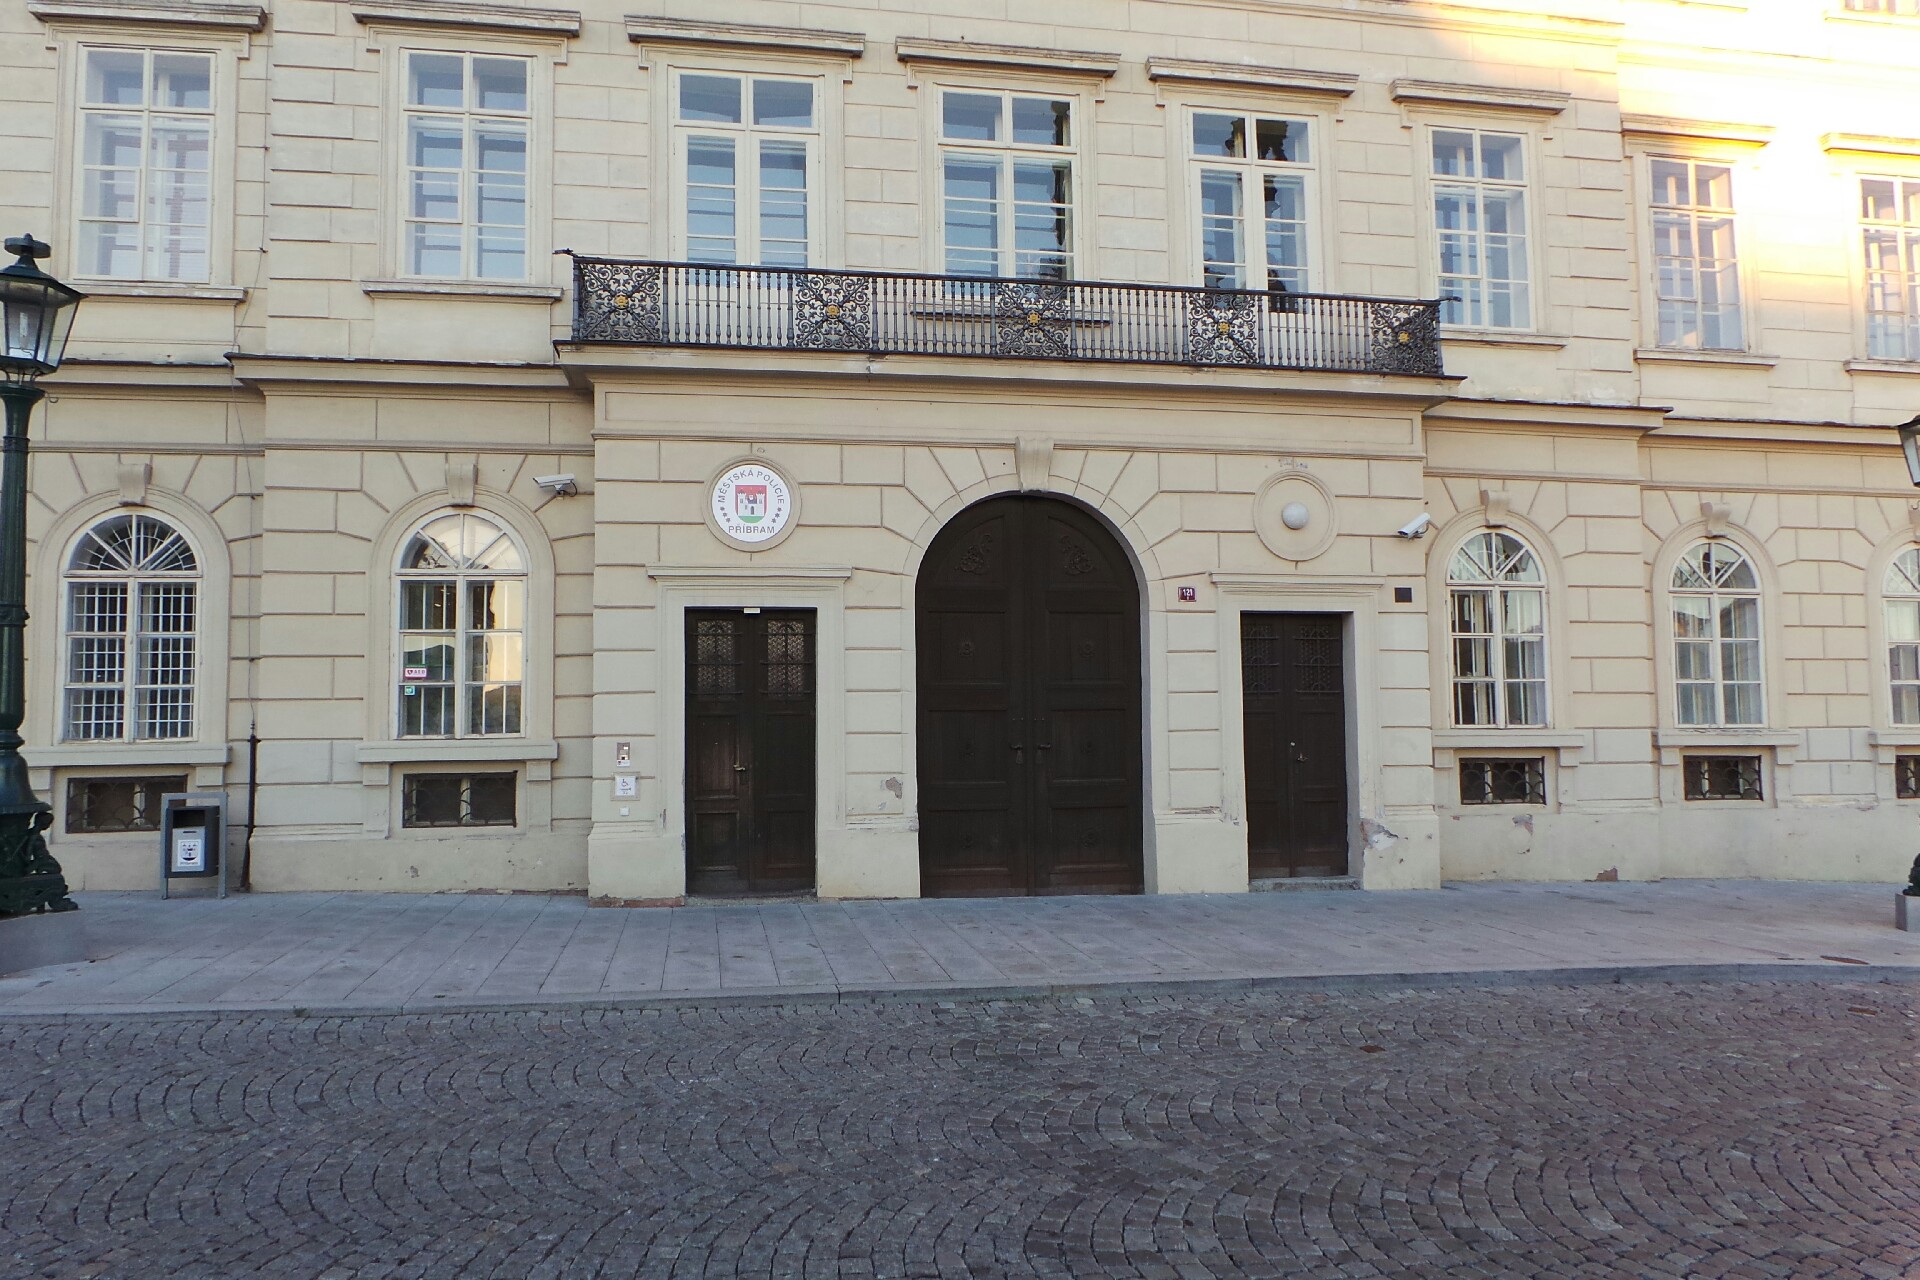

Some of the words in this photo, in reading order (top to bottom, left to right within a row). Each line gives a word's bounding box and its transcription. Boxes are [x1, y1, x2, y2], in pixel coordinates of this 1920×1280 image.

[717, 468, 754, 503] MĚSTSKÁ
[756, 470, 784, 504] POLICIE
[728, 523, 775, 534] PŘÍBRAM
[1182, 588, 1192, 596] 121
